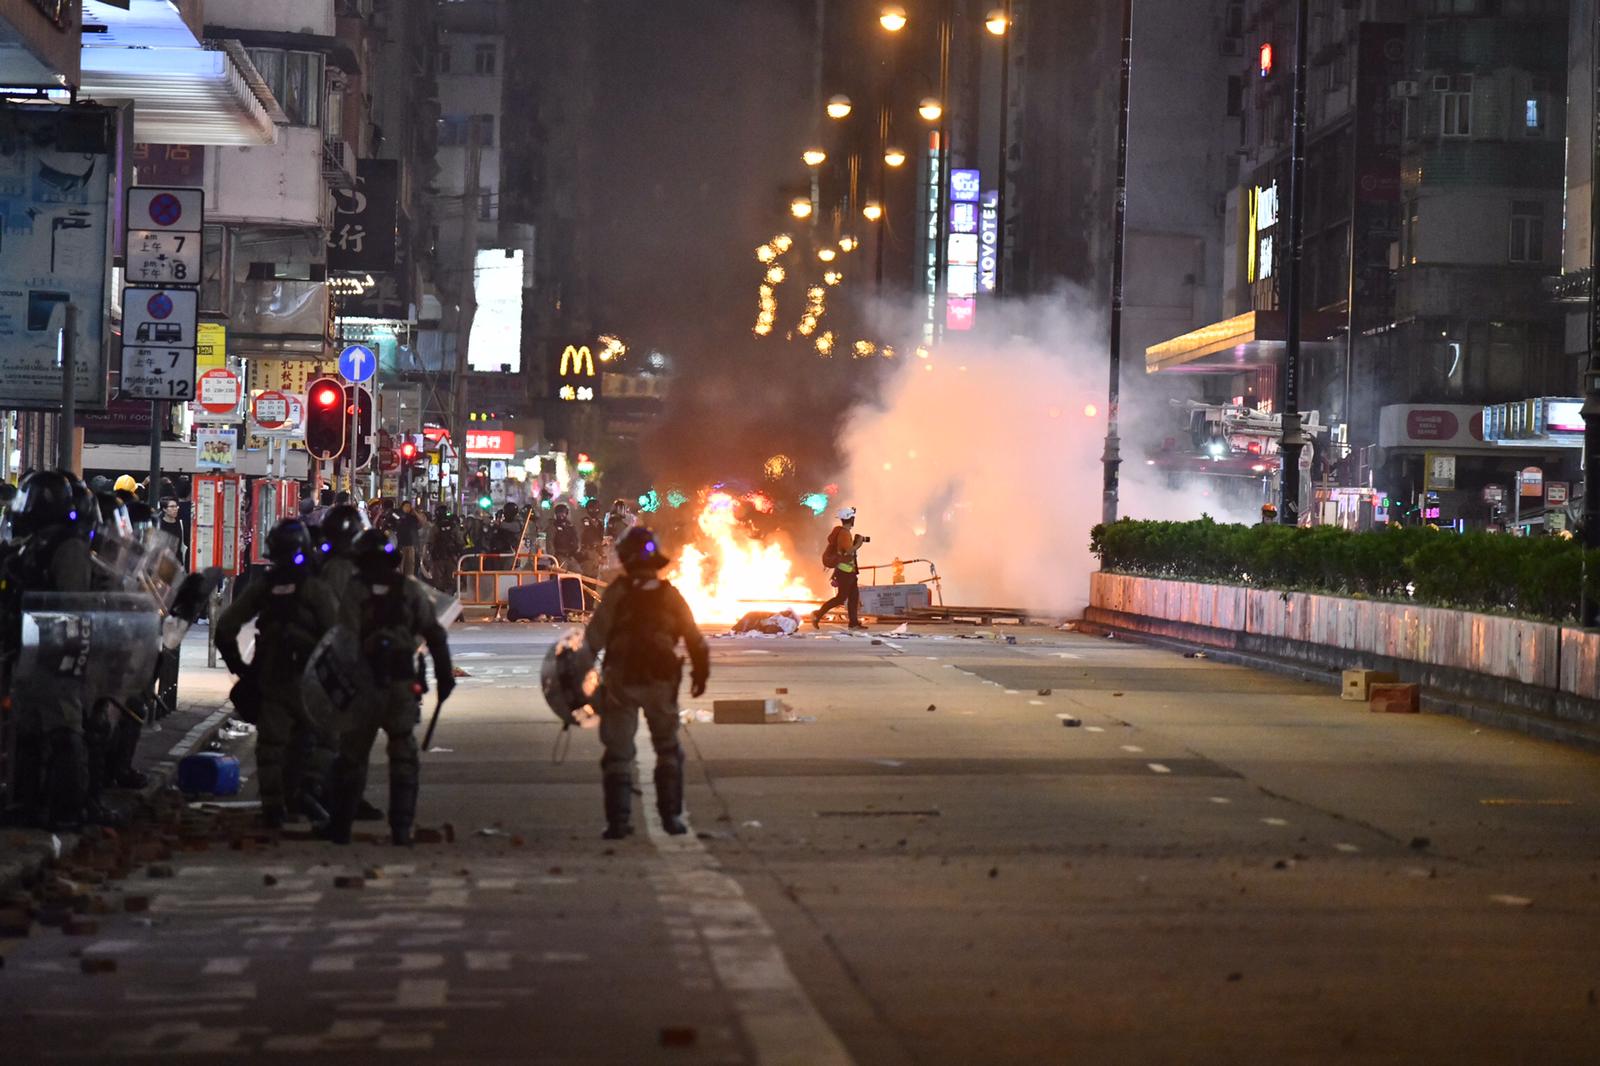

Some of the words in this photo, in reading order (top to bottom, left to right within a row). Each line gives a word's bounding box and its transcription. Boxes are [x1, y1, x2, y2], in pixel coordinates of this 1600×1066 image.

[140, 242, 161, 252] 上午
[173, 235, 186, 253] 7
[981, 198, 997, 287] NOVOTEL
[140, 268, 160, 279] 下午
[174, 263, 187, 280] 8
[134, 358, 155, 368] 上午
[167, 351, 180, 368] 7
[124, 376, 163, 386] midnight
[167, 379, 189, 397] 12
